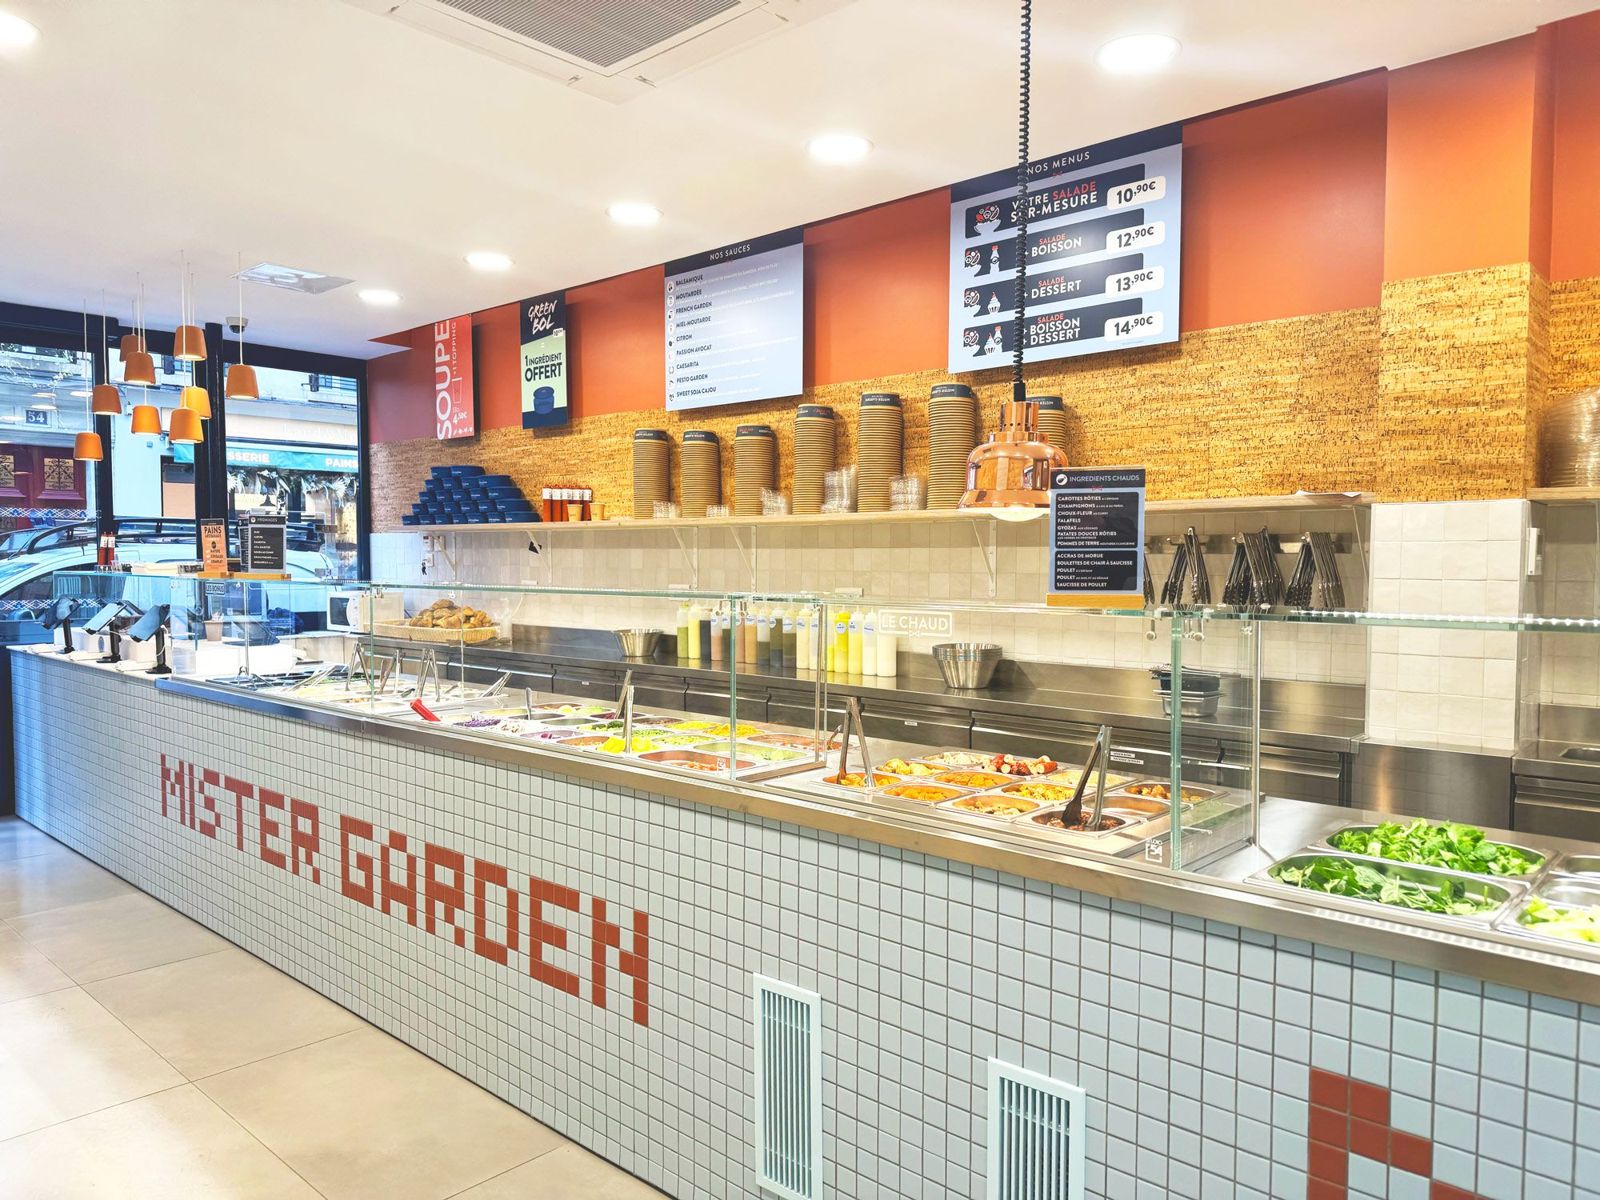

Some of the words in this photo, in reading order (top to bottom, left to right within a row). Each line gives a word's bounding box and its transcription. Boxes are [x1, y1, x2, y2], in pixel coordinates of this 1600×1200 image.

[1026, 162, 1049, 175] NOS
[1052, 151, 1091, 169] MENUS
[1052, 181, 1097, 200] SALADE
[1116, 180, 1156, 204] 10,90€
[1010, 191, 1098, 223] SR-MESURE
[1031, 236, 1082, 257] BOISSON
[1039, 233, 1066, 245] SALADE
[1116, 225, 1155, 249] 12,90€
[709, 251, 724, 261] NOS
[724, 243, 751, 257] SAUCES
[675, 274, 704, 286] BALSAMIQUE
[1031, 279, 1082, 299] DESSERT
[1038, 275, 1065, 287] SALADE
[1115, 270, 1153, 292] 13,90€
[528, 300, 558, 321] GREEN
[675, 304, 694, 314] FRENCH
[693, 301, 713, 311] GARDEN
[532, 314, 555, 335] BOL
[1030, 317, 1081, 335] BOISSON
[1037, 313, 1065, 324] SALADE
[1114, 315, 1153, 337] 14,90€
[1030, 327, 1081, 346] DESSERT
[694, 344, 713, 353] AVOCAT
[528, 352, 562, 366] INGRÉDIENT
[435, 320, 452, 440] SOUPE
[525, 362, 562, 382] OFFERT
[1112, 474, 1140, 482] CHAUDS
[204, 526, 222, 534] PAINS
[882, 615, 896, 628] LE
[899, 615, 949, 631] CHAUD
[160, 753, 321, 886] MISTER
[339, 814, 649, 1028] GARDEN
